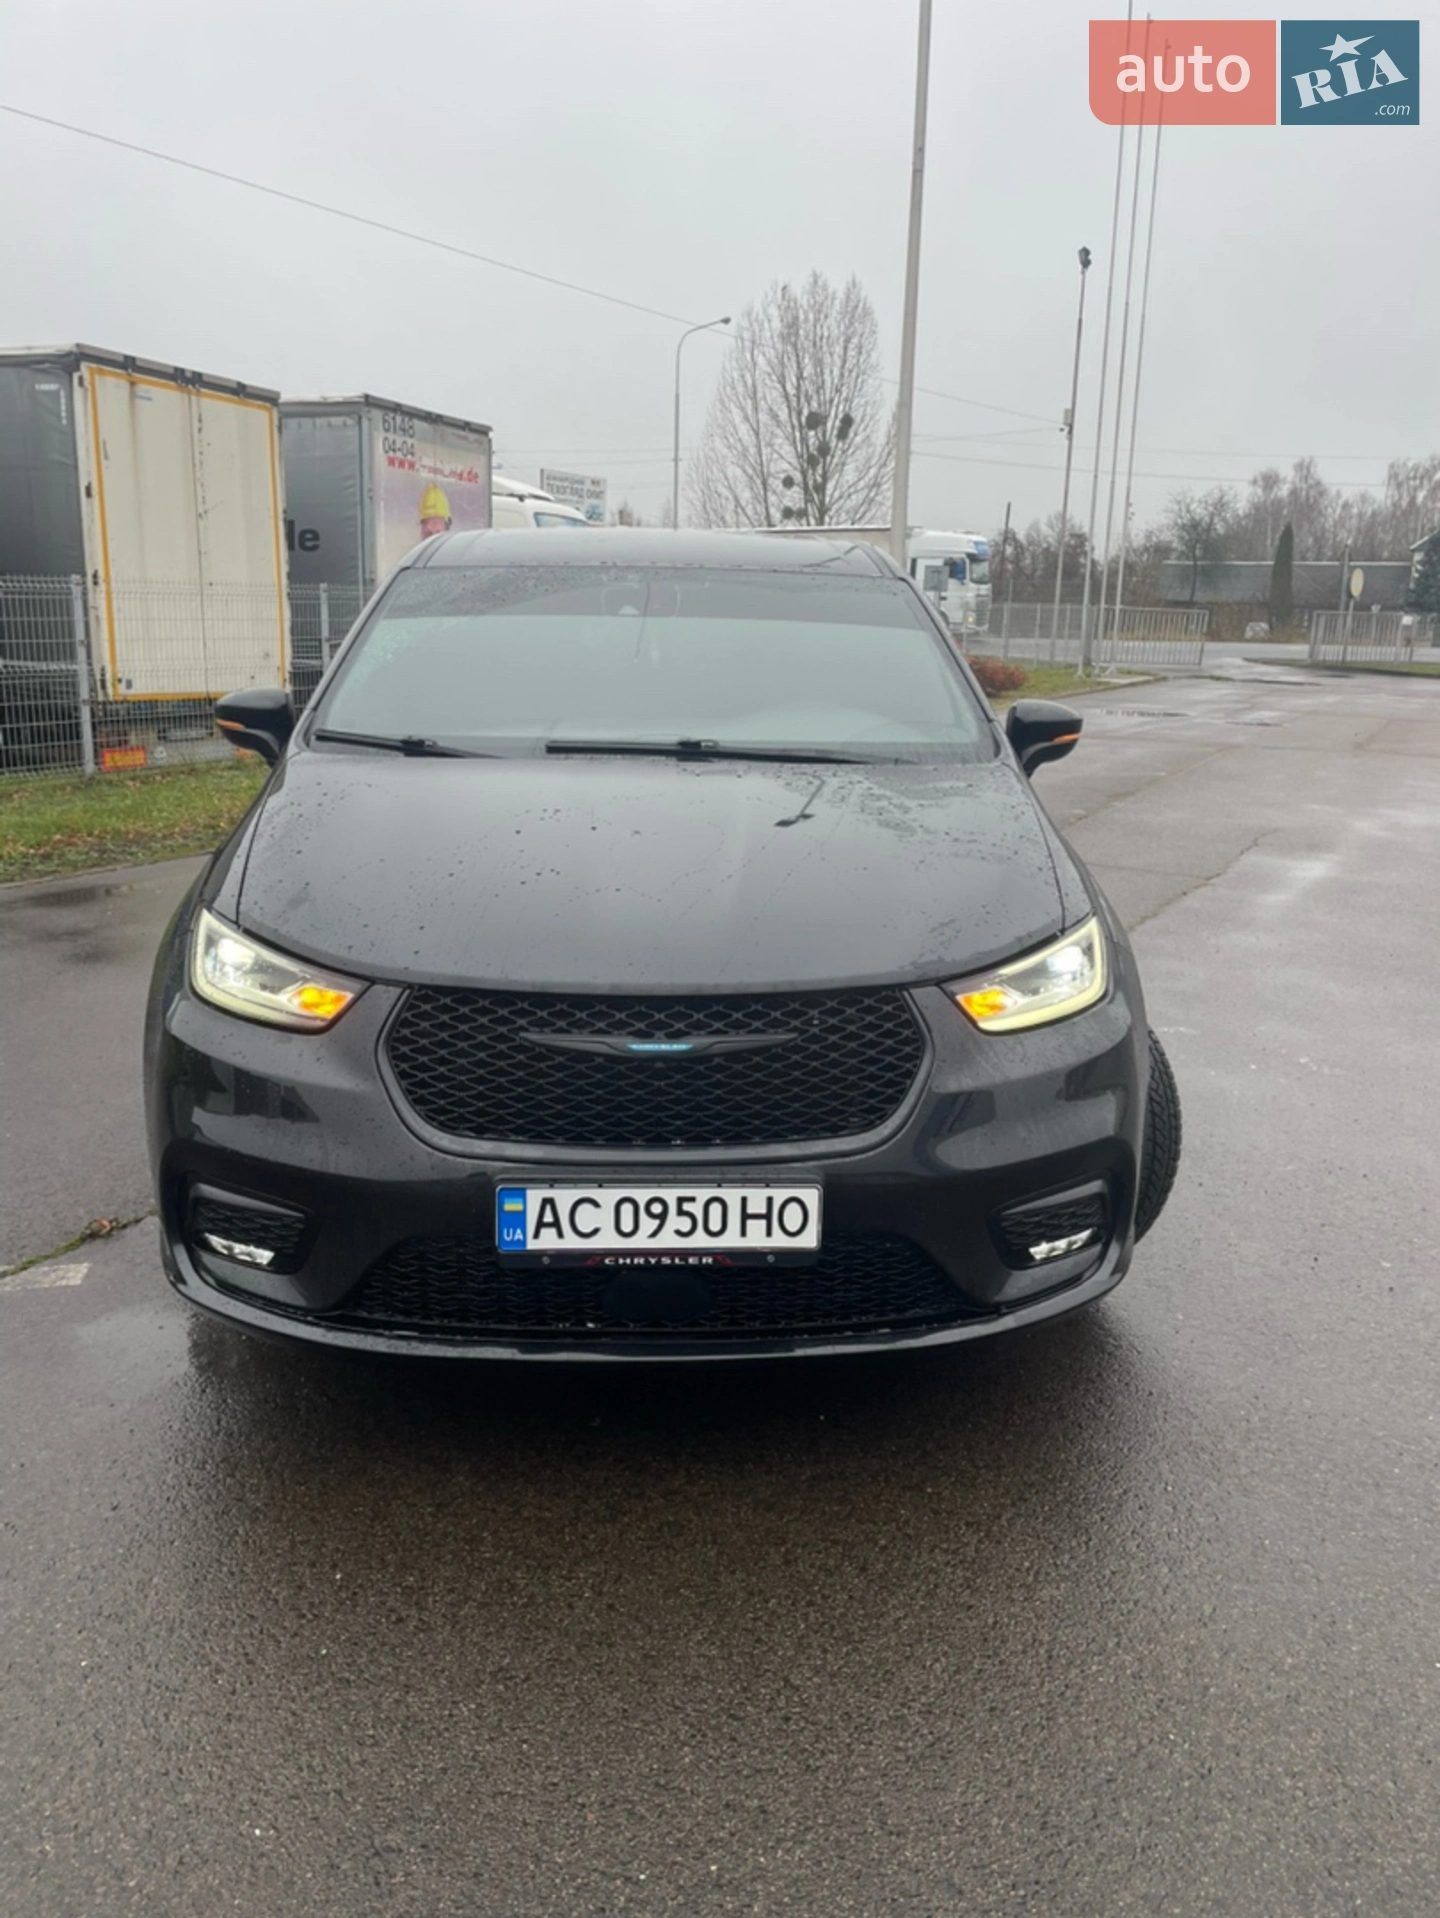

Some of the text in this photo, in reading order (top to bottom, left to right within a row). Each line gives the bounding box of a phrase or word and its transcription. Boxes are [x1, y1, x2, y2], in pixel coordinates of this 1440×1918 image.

[382, 412, 415, 438] 6148
[382, 436, 415, 457] 04-04
[613, 1195, 729, 1239] 0950
[503, 1228, 524, 1241] UA
[604, 1256, 714, 1266] CHRYSLER
